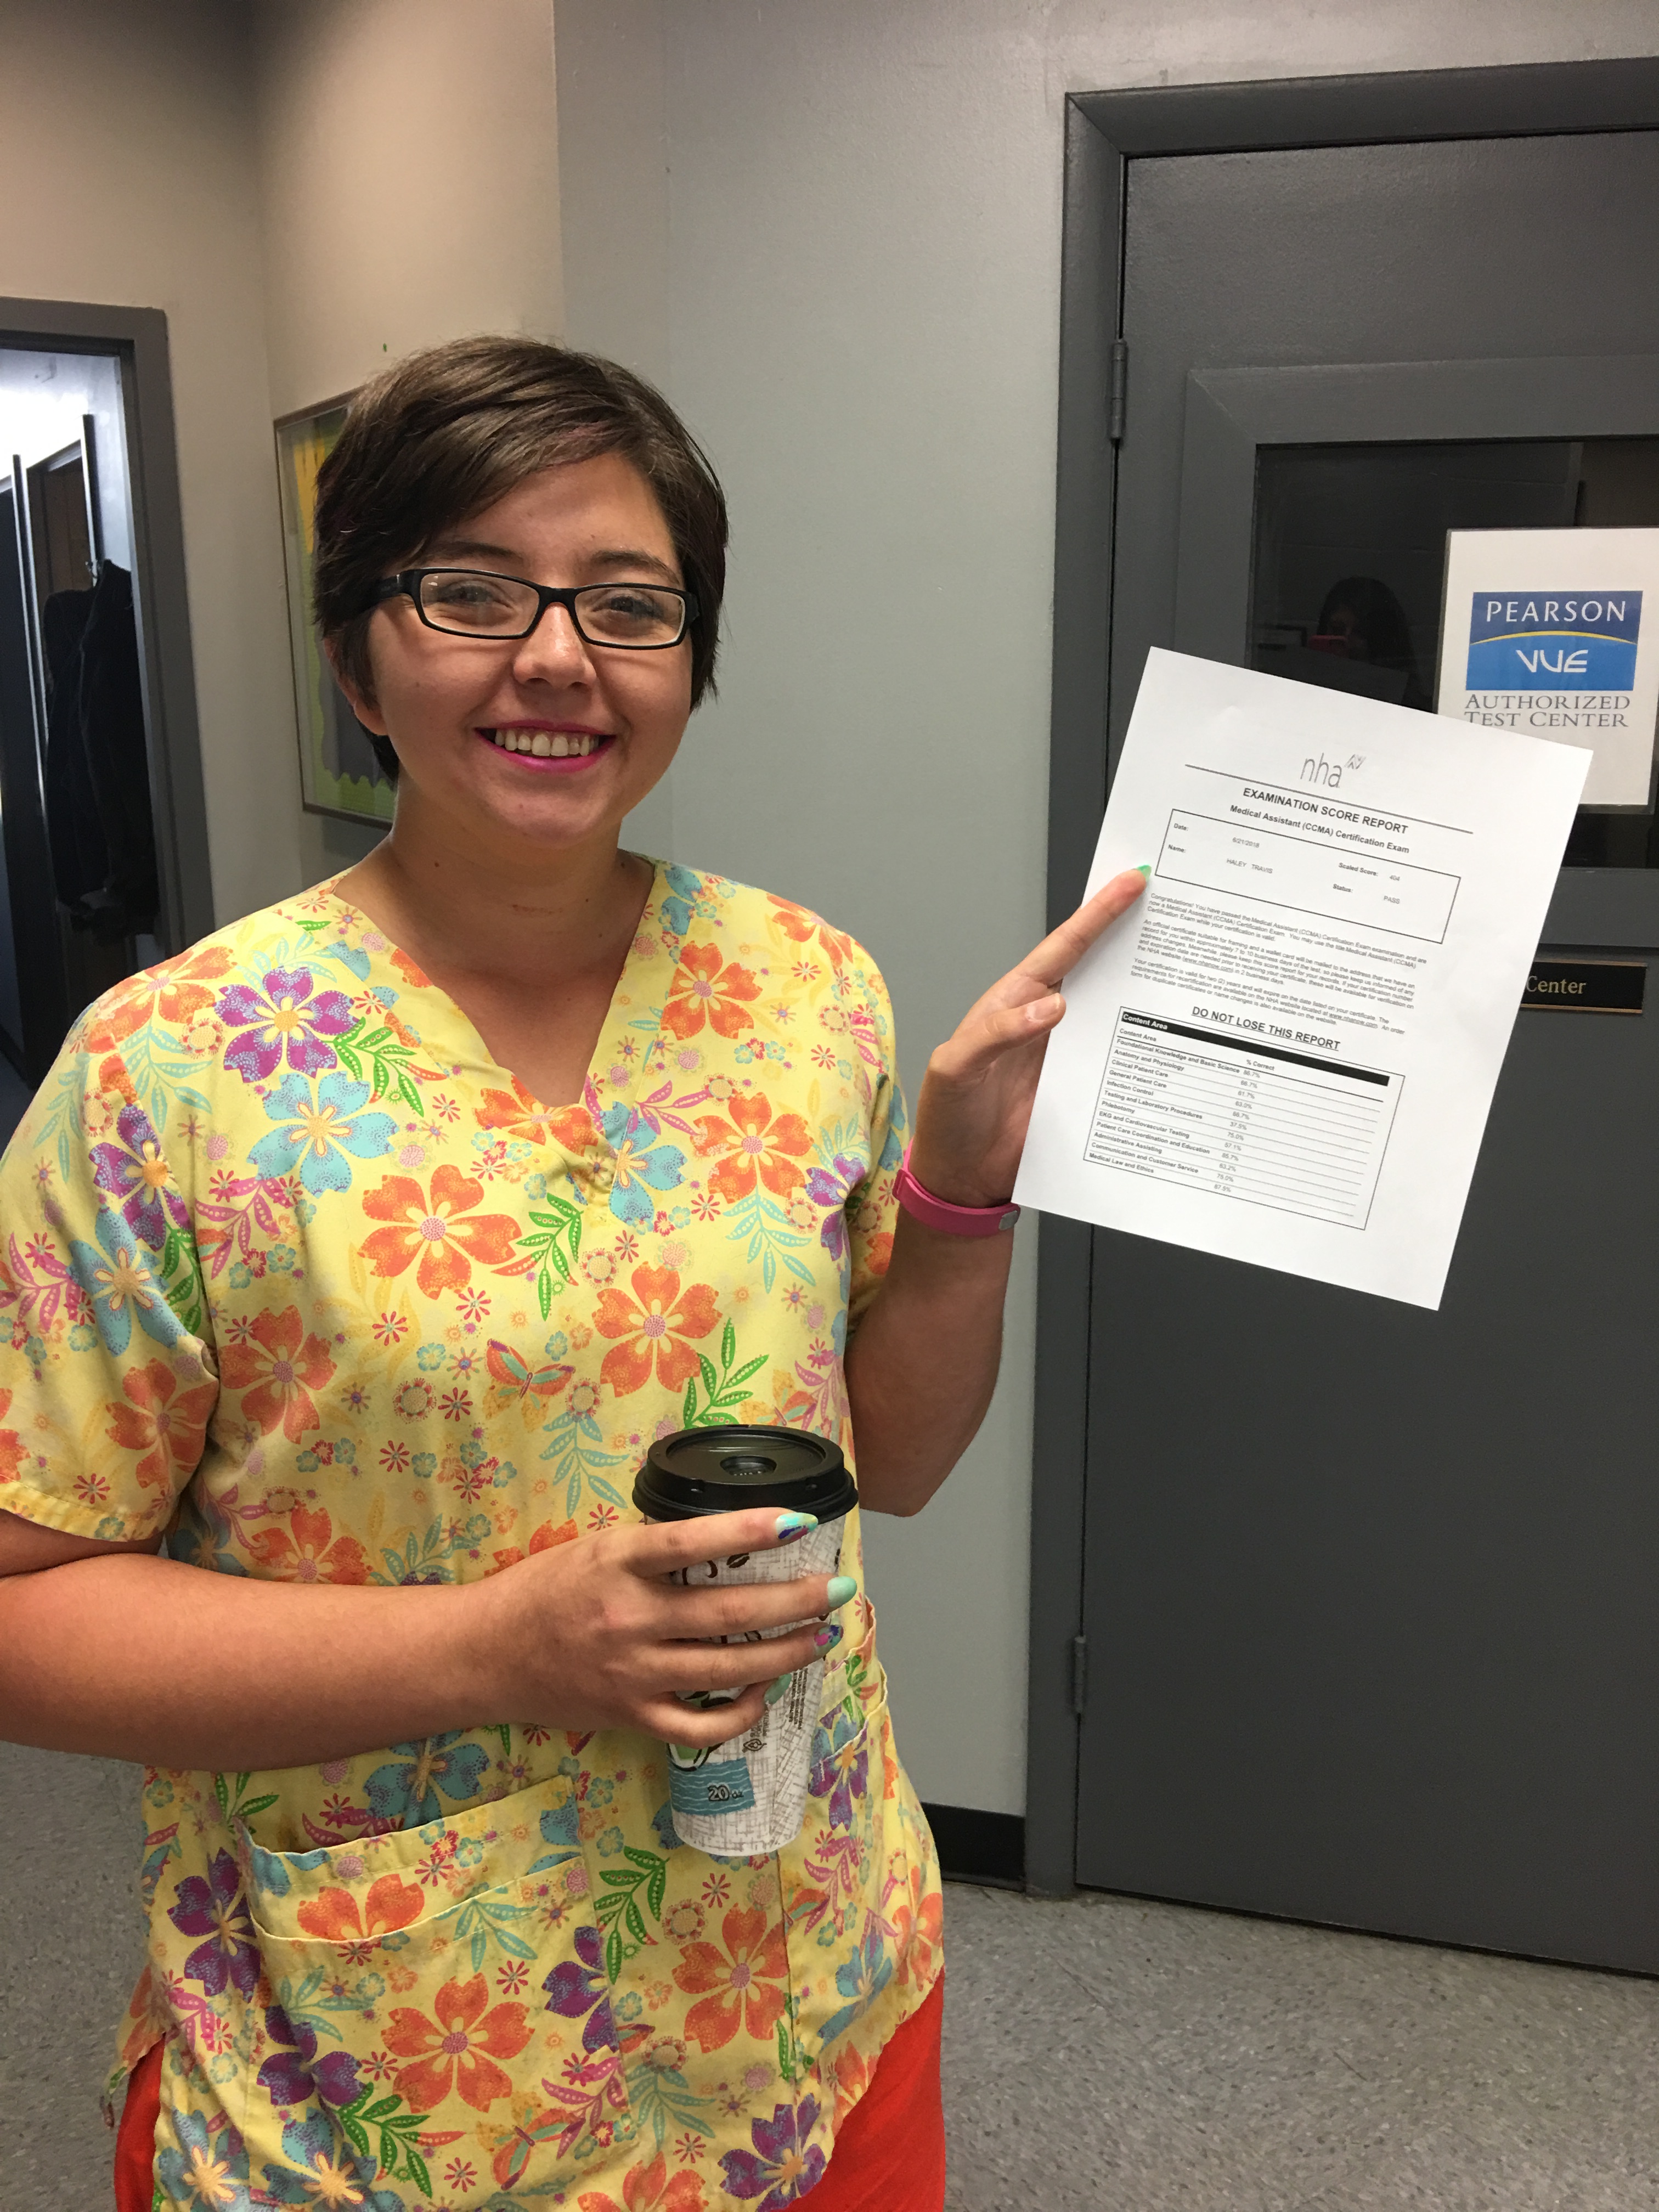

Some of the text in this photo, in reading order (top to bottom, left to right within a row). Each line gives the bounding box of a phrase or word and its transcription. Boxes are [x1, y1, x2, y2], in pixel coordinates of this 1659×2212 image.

[1486, 600, 1626, 622] PEARSON
[1515, 649, 1589, 673] VUE
[1464, 693, 1630, 710] AUTHORIZED
[1464, 712, 1629, 727] TEST CENTER
[1300, 752, 1344, 788] nha
[1243, 787, 1408, 833] EXAMINATION SCORE REPORT
[1173, 822, 1188, 831] Date:
[1230, 804, 1409, 853] Medical Assistant (CCMA) Certification Exam
[1167, 844, 1273, 874] Name: HALEY TRAVIS
[1338, 862, 1359, 872] Scaled
[1359, 867, 1378, 876] Score:
[1333, 883, 1400, 904] Status: PASS
[1526, 975, 1587, 994] Center
[1122, 1012, 1167, 1030] Content Area
[1192, 1006, 1341, 1049] DO NOT LOSE THIS REPORT
[1114, 1049, 1139, 1060] Anatomy
[1152, 1058, 1184, 1071] Physiology
[1116, 1039, 1154, 1052] Foundational
[1154, 1048, 1187, 1060] Knowledge
[1200, 1059, 1216, 1067] Basic
[1217, 1063, 1240, 1073] Science
[1119, 1028, 1142, 1038] Content
[1252, 1060, 1275, 1071] Correct
[1109, 1069, 1131, 1080] General
[1132, 1075, 1153, 1085] Patient
[1111, 1059, 1133, 1069] Clinical
[1133, 1064, 1154, 1074] Patient
[1106, 1080, 1131, 1090] Infection
[1132, 1086, 1154, 1096] Control
[1101, 1100, 1135, 1114] Phlebotomy
[1104, 1090, 1125, 1101] Testing
[1137, 1098, 1169, 1111] Laboratory
[1170, 1107, 1203, 1119] Procedures
[1099, 1110, 1112, 1119] EKG
[1125, 1118, 1167, 1132] Cardiovascular
[1169, 1128, 1190, 1139] Testing
[1093, 1132, 1135, 1146] Administrative
[1135, 1142, 1163, 1154] Assisting
[1096, 1121, 1116, 1131] Patient
[1132, 1130, 1169, 1143] Coordination
[1181, 1142, 1210, 1154] Education
[1088, 1152, 1111, 1163] Medical
[1136, 1164, 1154, 1173] Ethics
[1091, 1142, 1136, 1158] Communication
[1148, 1156, 1176, 1167] Customer
[1177, 1163, 1199, 1173] Service
[707, 1784, 730, 1802] 20
